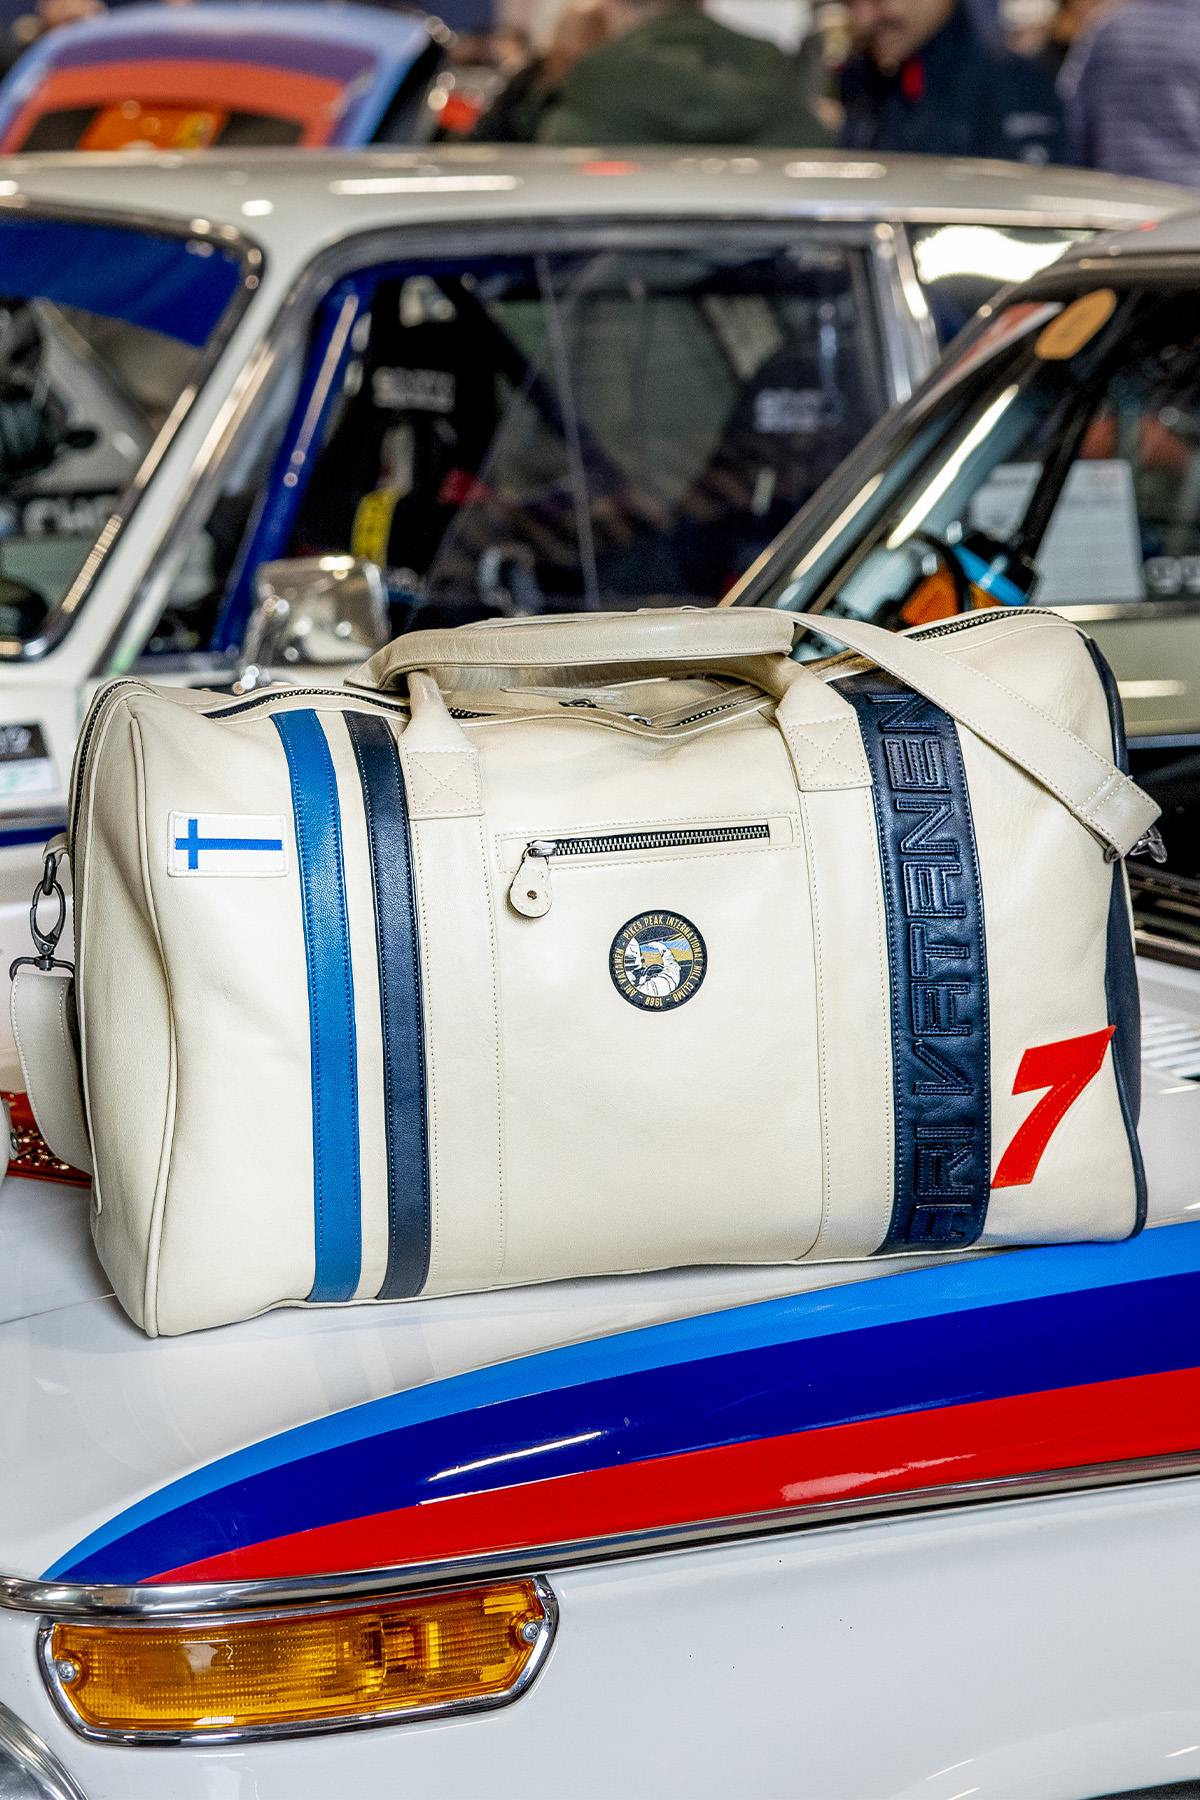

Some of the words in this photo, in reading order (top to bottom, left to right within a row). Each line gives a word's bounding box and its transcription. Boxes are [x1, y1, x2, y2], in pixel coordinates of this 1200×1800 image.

[867, 692, 976, 1097] VATANEN
[624, 921, 643, 940] PIKES
[644, 915, 663, 927] PEAK
[666, 916, 703, 962] INTERNATIONAL
[613, 948, 628, 984] VATANEN
[692, 963, 703, 981] HILL
[623, 986, 638, 998] ARI
[673, 984, 694, 1002] CLIMB
[645, 997, 662, 1007] 1988
[991, 1026, 1115, 1189] 7
[906, 1126, 975, 1242] ARI
